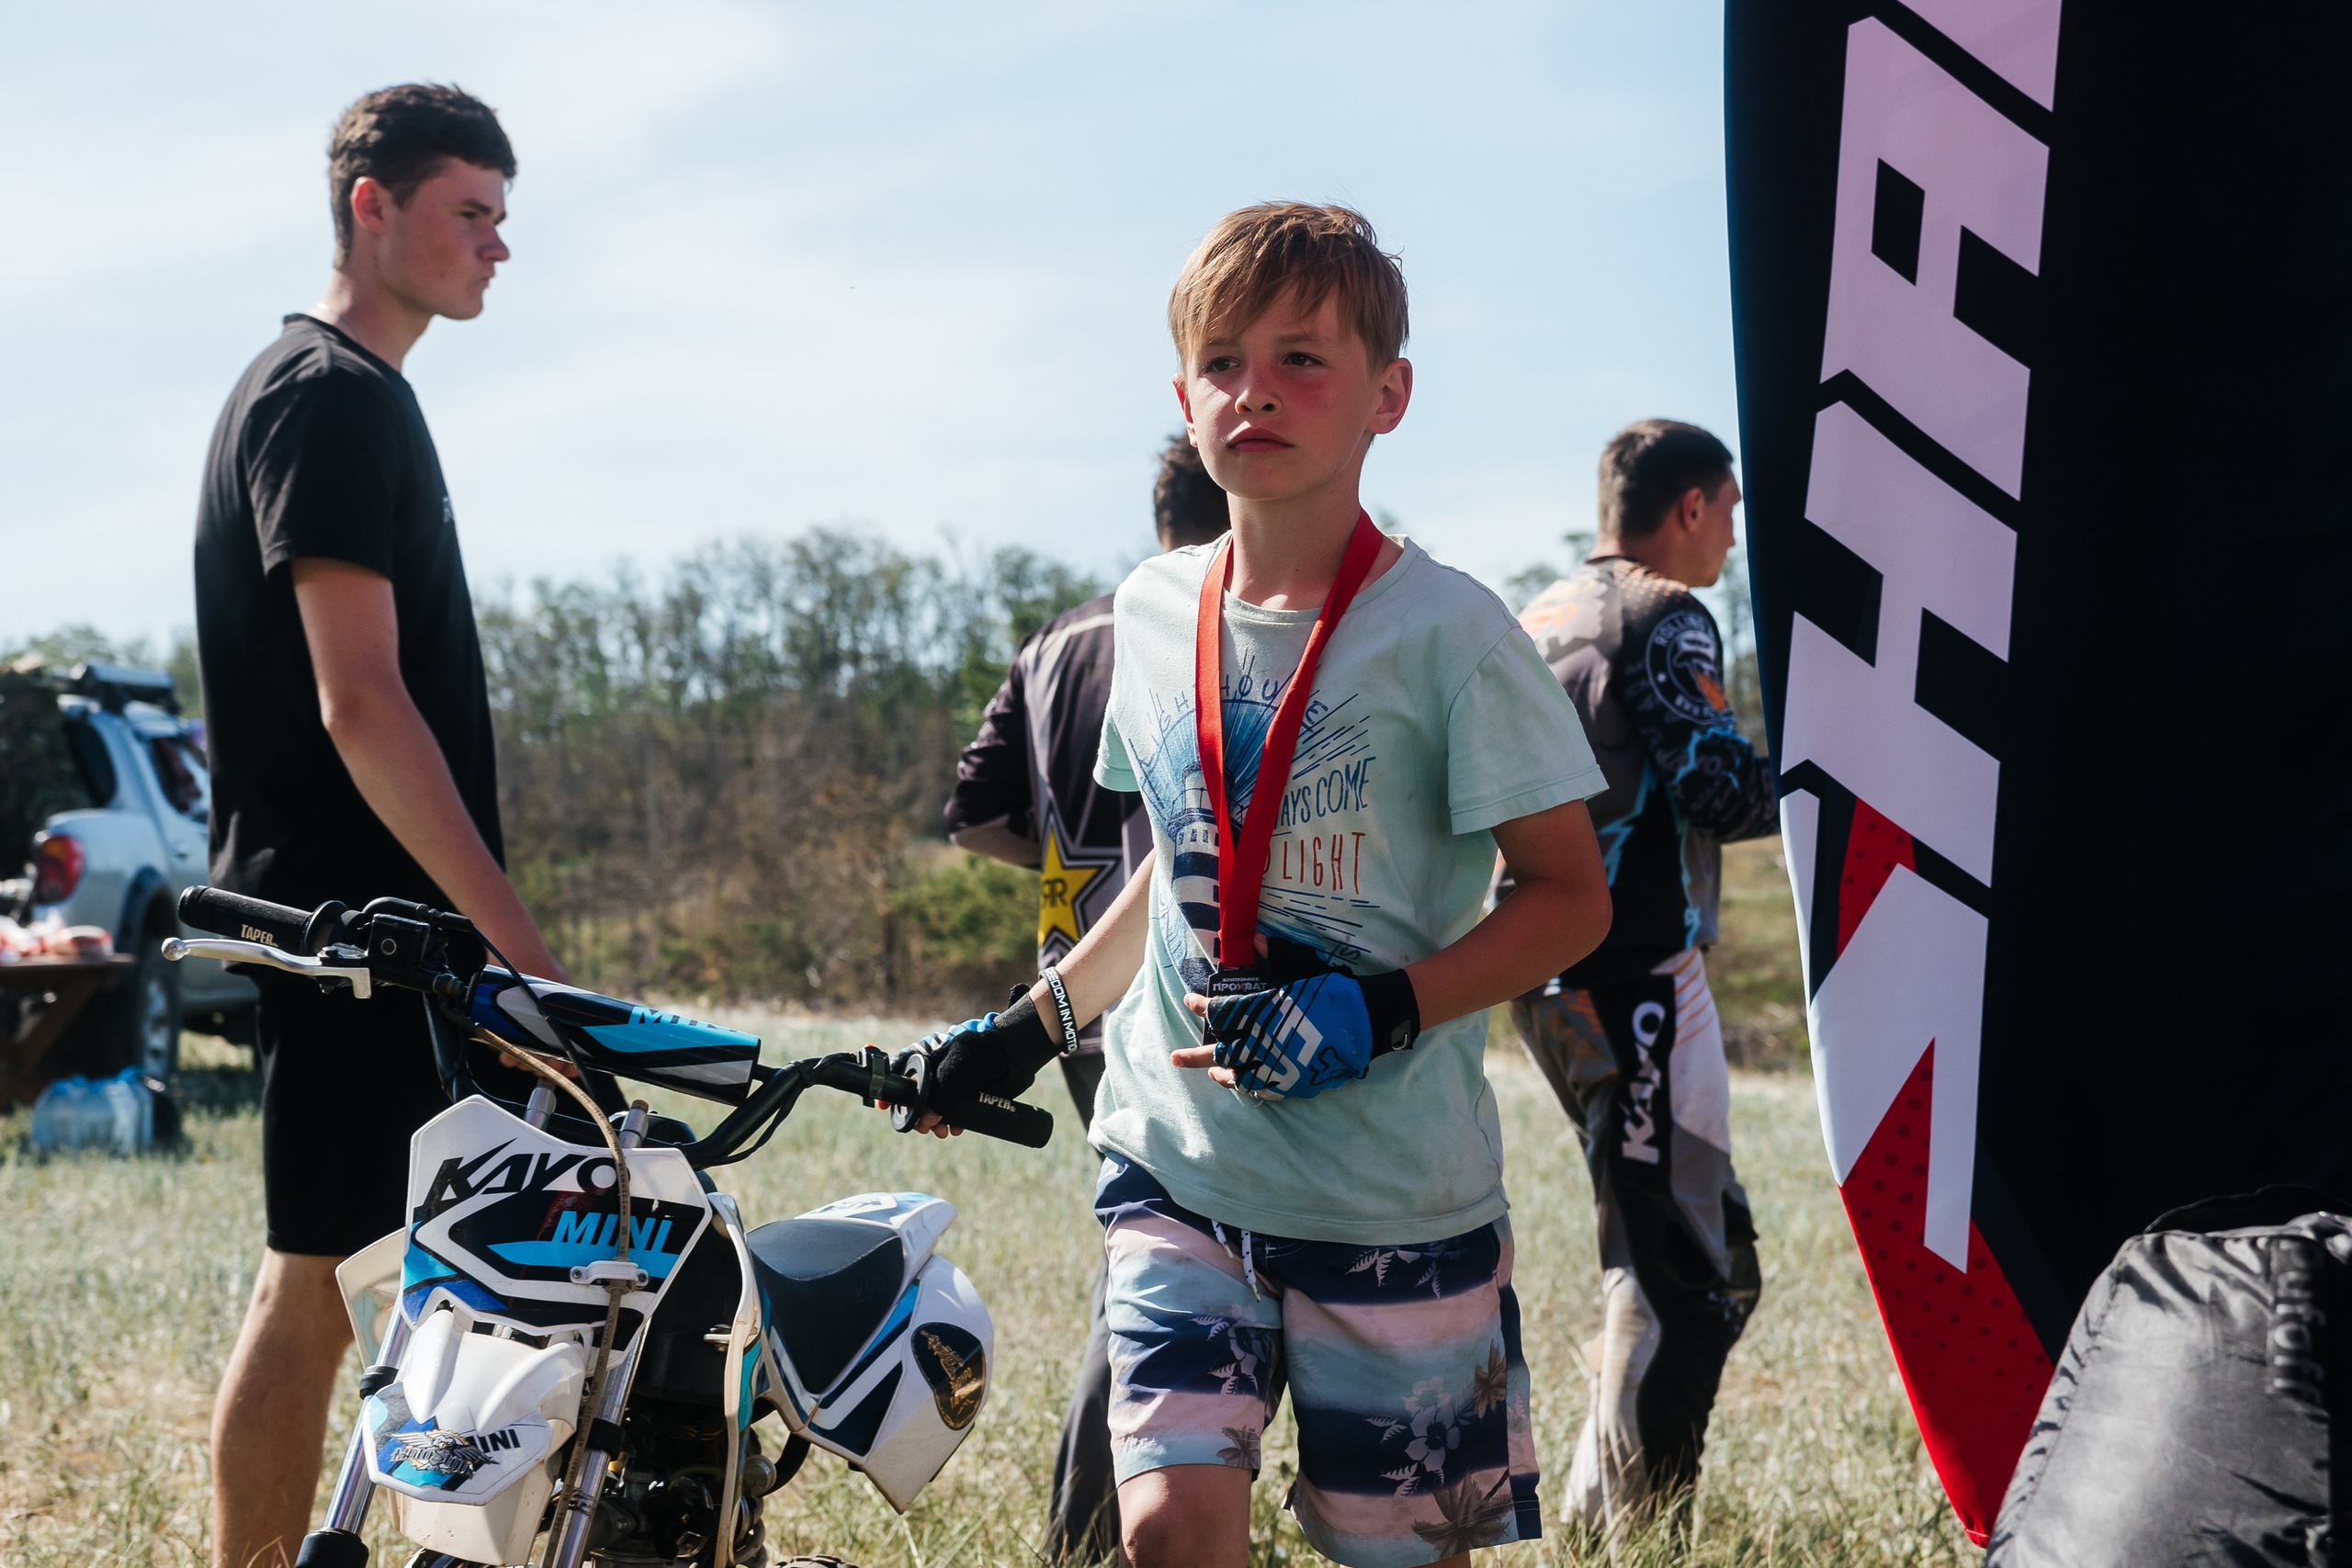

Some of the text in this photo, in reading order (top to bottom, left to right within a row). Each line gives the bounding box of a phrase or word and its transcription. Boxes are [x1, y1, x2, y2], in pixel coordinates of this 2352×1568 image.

[1316, 756, 1376, 818] COME
[1283, 831, 1366, 895] LIGHT
[241, 923, 276, 946] TAPER
[1213, 982, 1268, 992] ПРОХВАТ
[1059, 1009, 1073, 1021] IN
[421, 1137, 630, 1211] KAYO
[552, 1210, 673, 1253] MINI
